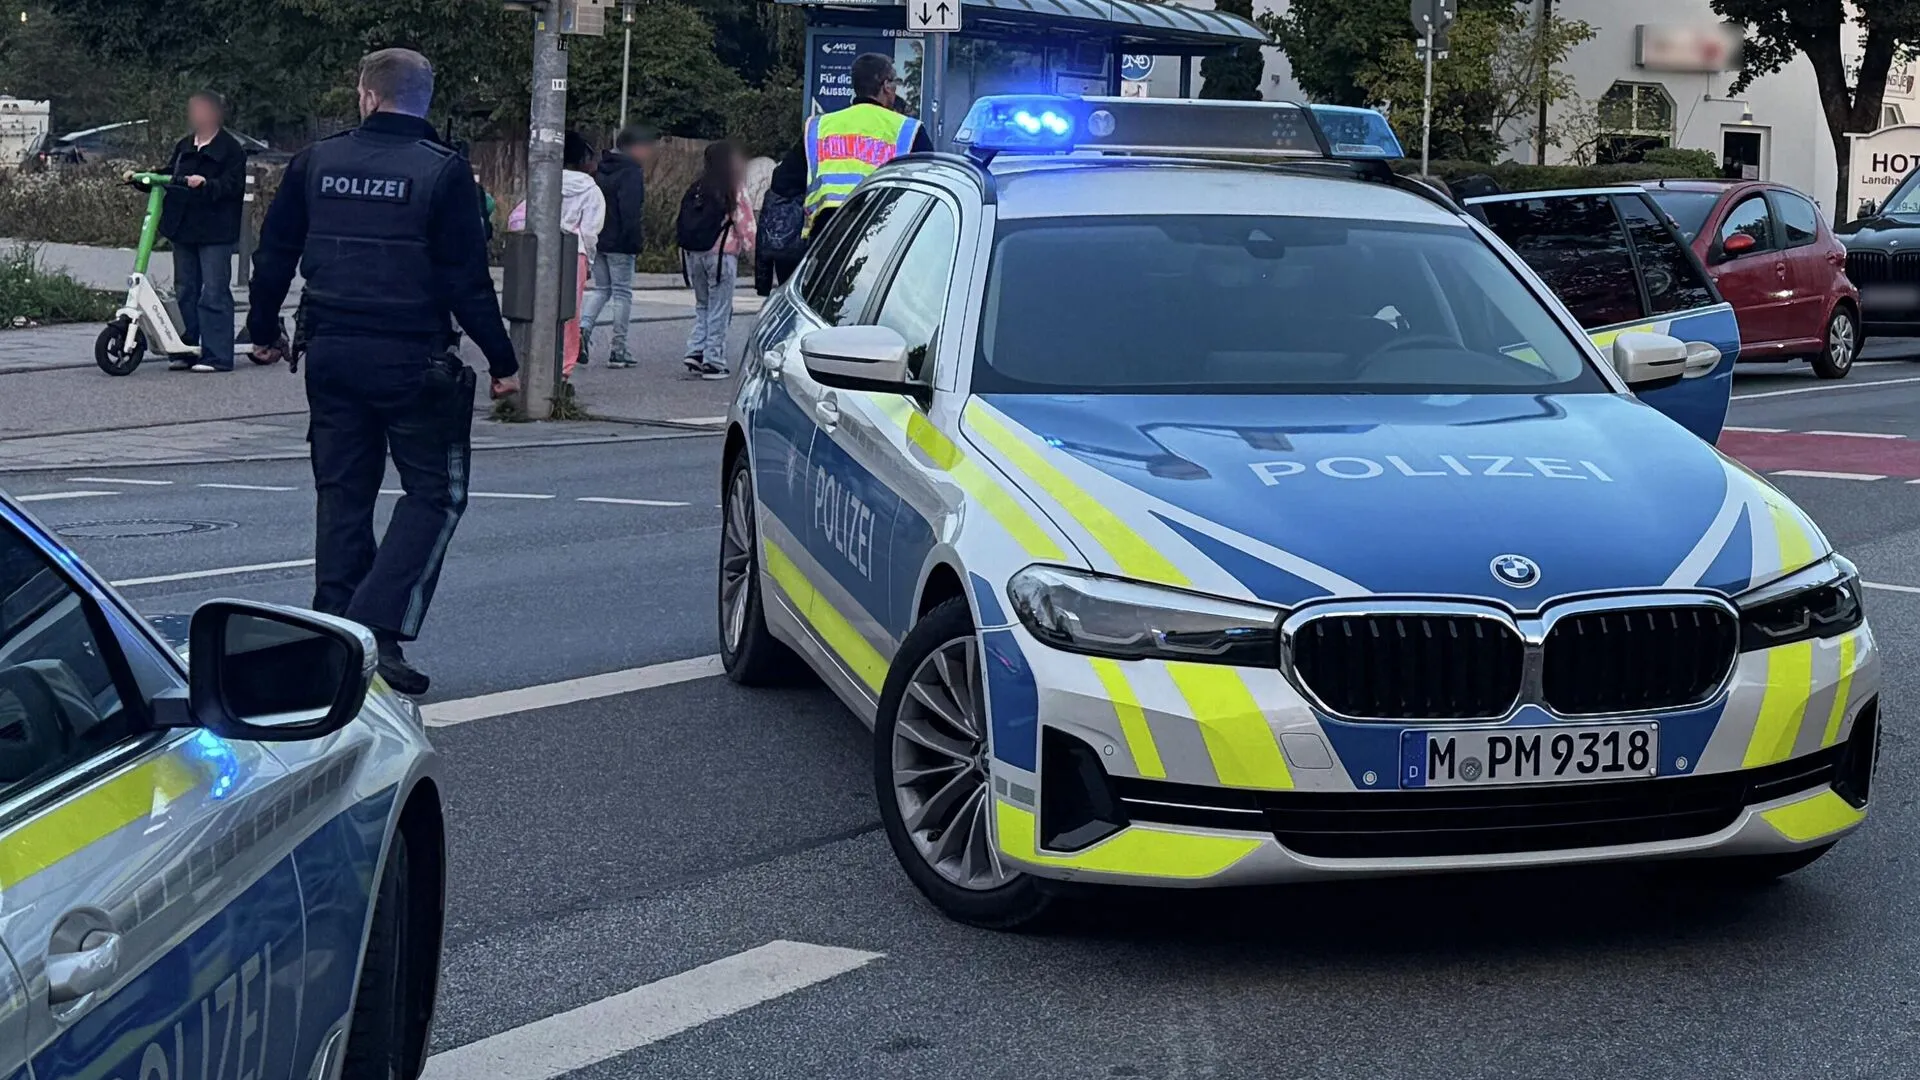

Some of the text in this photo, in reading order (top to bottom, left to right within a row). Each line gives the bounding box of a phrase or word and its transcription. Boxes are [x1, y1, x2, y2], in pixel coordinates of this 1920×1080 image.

[832, 42, 857, 51] MVG
[820, 73, 836, 84] Für
[321, 176, 405, 198] POLIZEI
[1248, 455, 1615, 486] POLIZEI
[814, 464, 876, 582] POLIZEI
[1409, 730, 1650, 780] D M PM 9318
